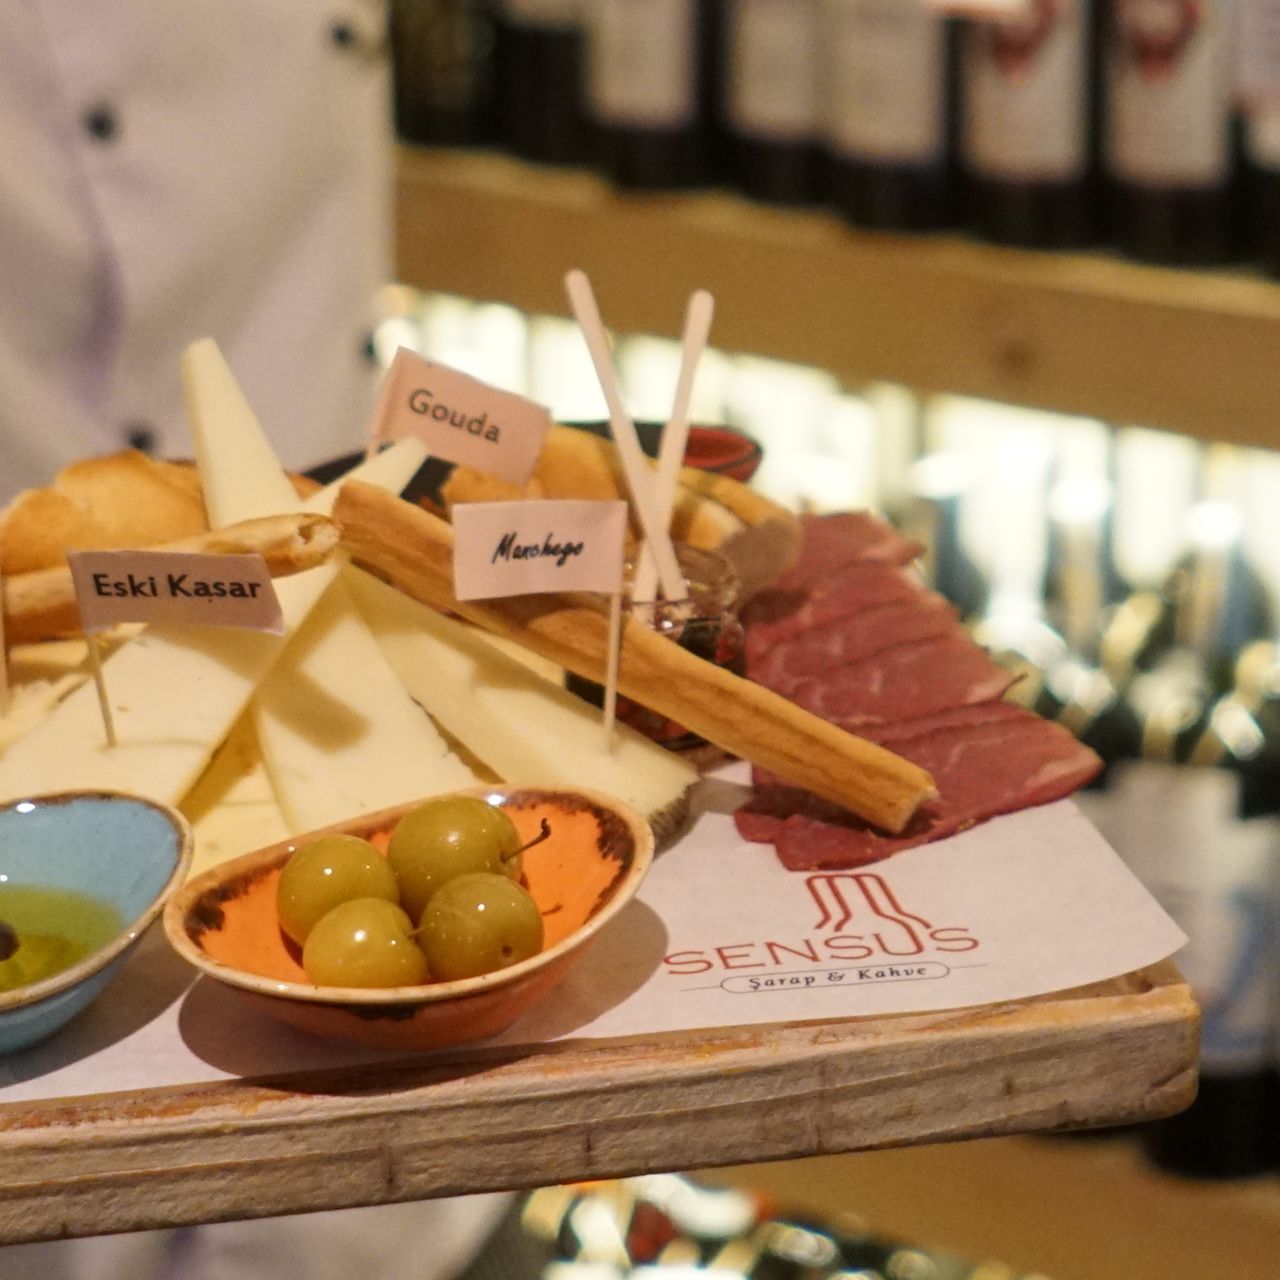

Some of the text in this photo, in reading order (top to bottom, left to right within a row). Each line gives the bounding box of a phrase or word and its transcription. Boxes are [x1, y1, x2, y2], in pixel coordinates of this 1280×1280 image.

[408, 387, 501, 445] Gouda
[92, 573, 159, 598] Eski
[662, 926, 980, 976] SENSUS
[826, 970, 846, 983] &
[857, 963, 928, 980] Kahve
